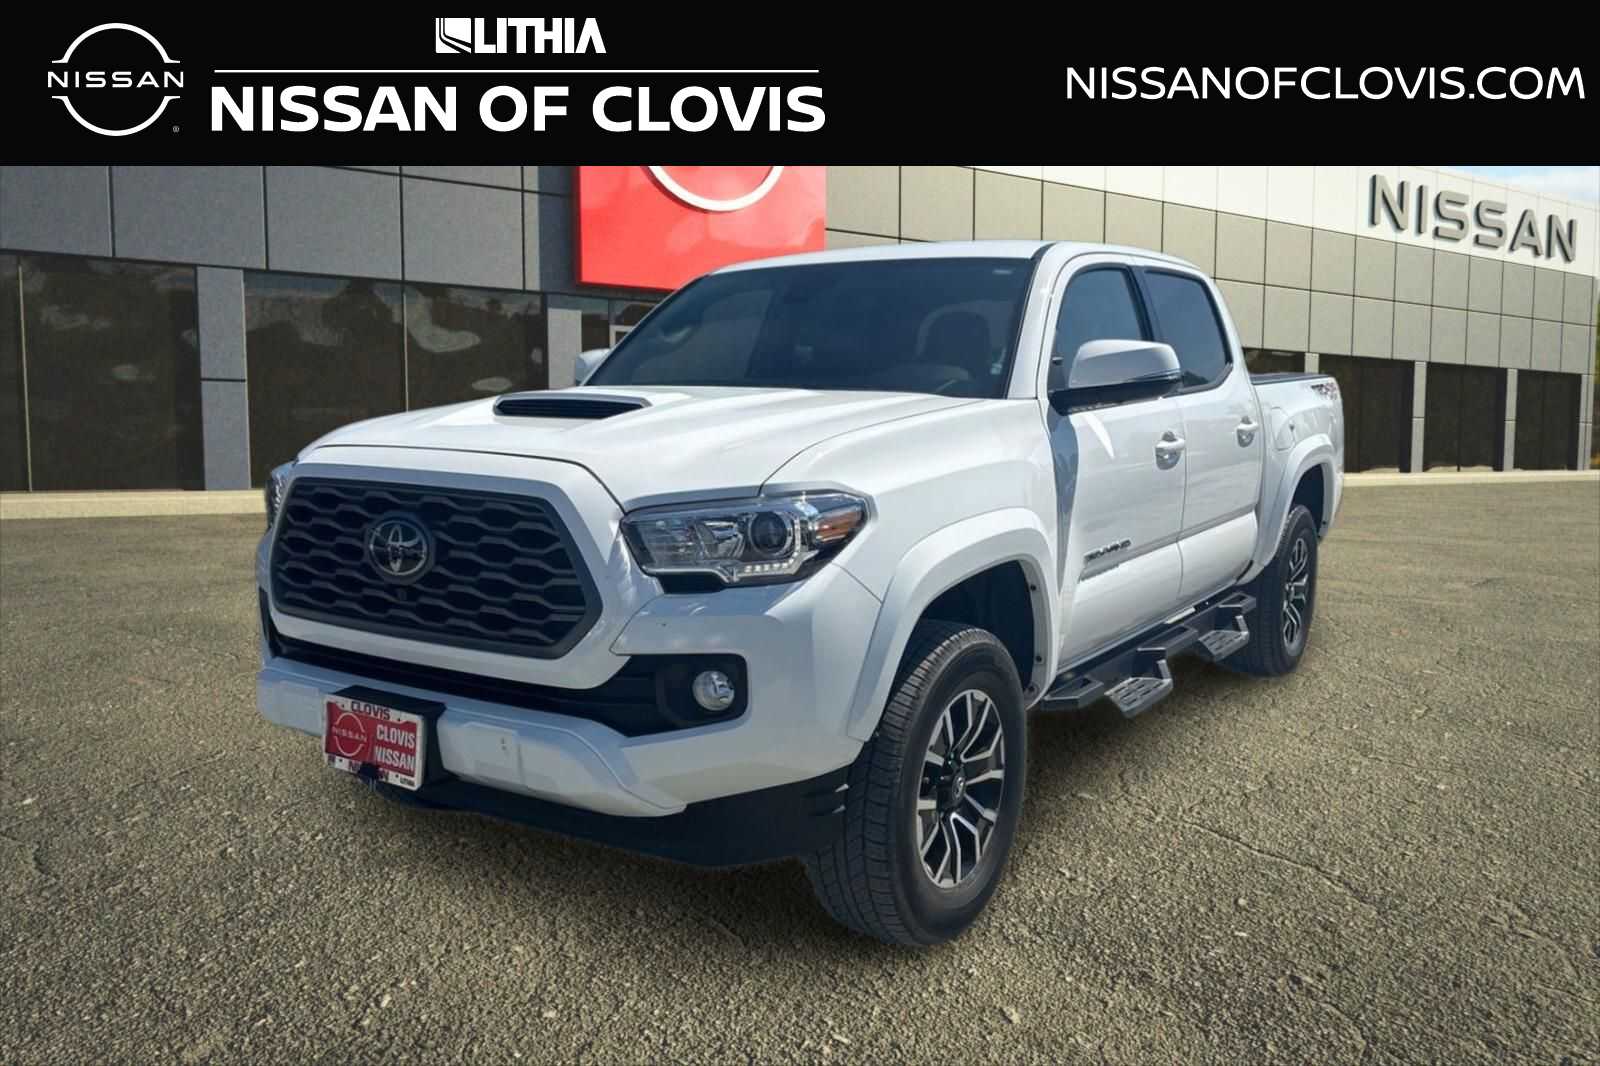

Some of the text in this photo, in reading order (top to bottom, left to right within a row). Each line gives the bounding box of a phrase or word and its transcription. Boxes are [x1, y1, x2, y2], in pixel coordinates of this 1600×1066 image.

[1369, 174, 1577, 263] NISSAN
[350, 701, 391, 720] CLOVIS
[376, 724, 416, 749] CLOVIS
[374, 746, 416, 772] NISSAN
